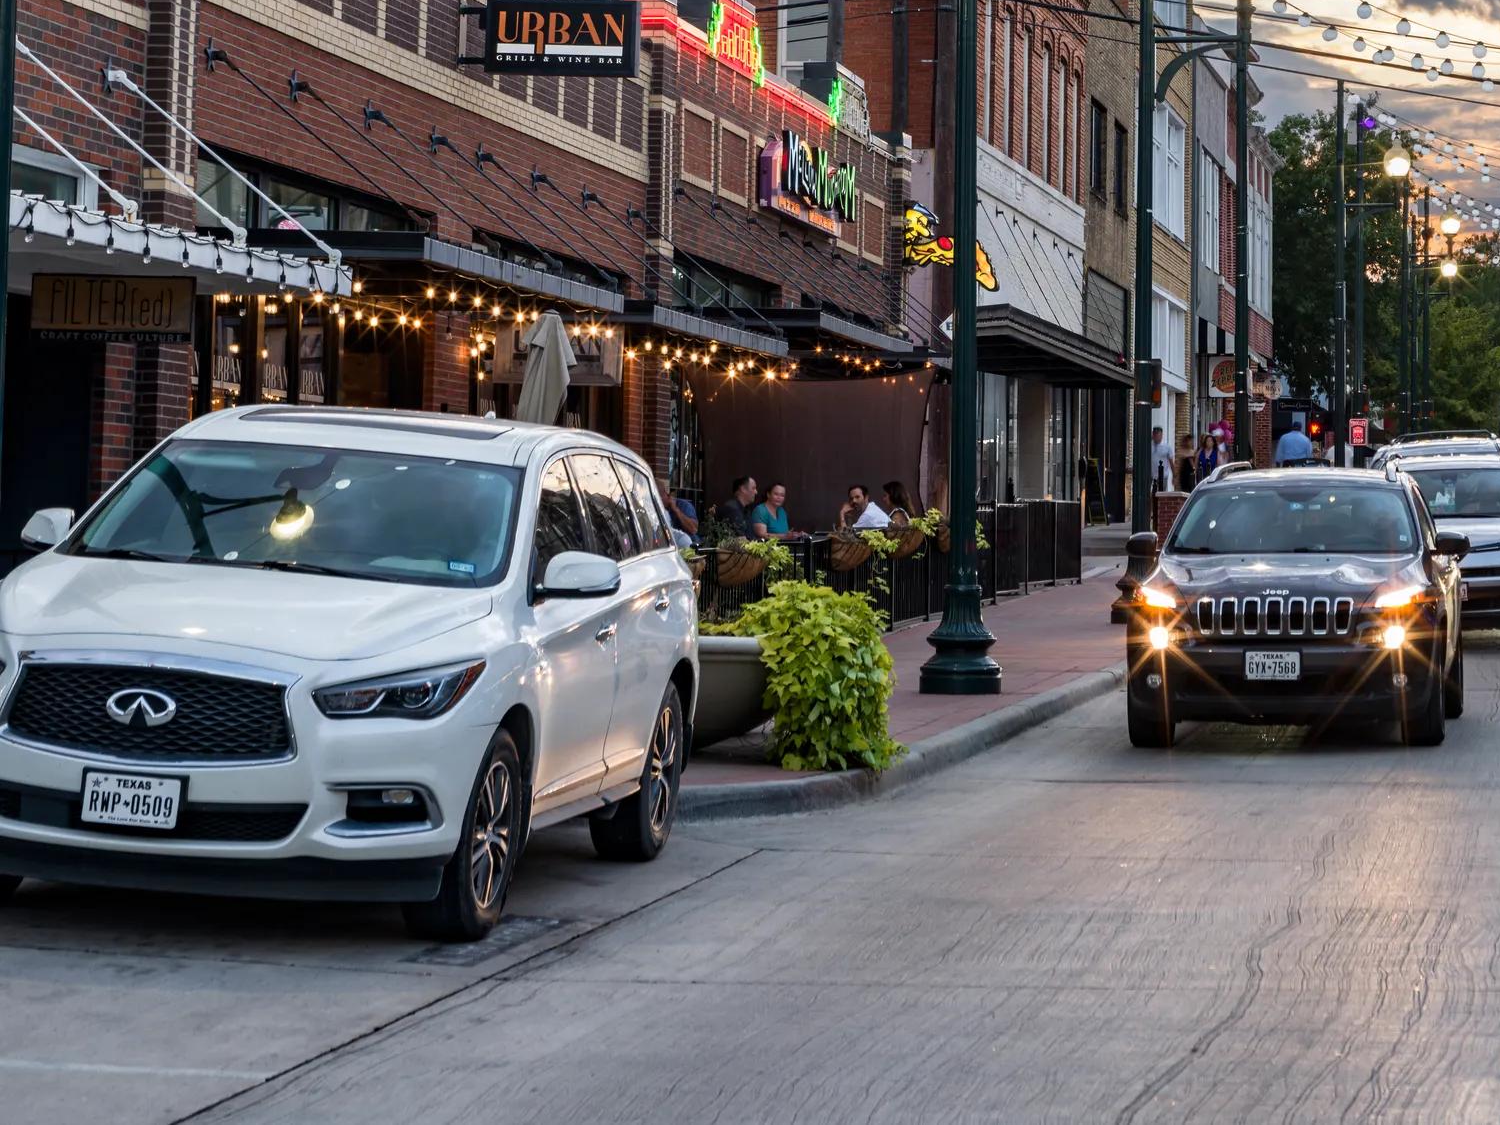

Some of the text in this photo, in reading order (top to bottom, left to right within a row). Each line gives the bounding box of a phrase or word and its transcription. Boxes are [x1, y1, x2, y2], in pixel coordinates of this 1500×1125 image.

[498, 10, 624, 54] URBAN
[496, 54, 535, 62] GRILL
[40, 331, 184, 342] CRAFT COFFEE CULTURE
[212, 355, 242, 382] URBAN
[1263, 588, 1290, 596] Jeep
[116, 778, 152, 791] TEXAS
